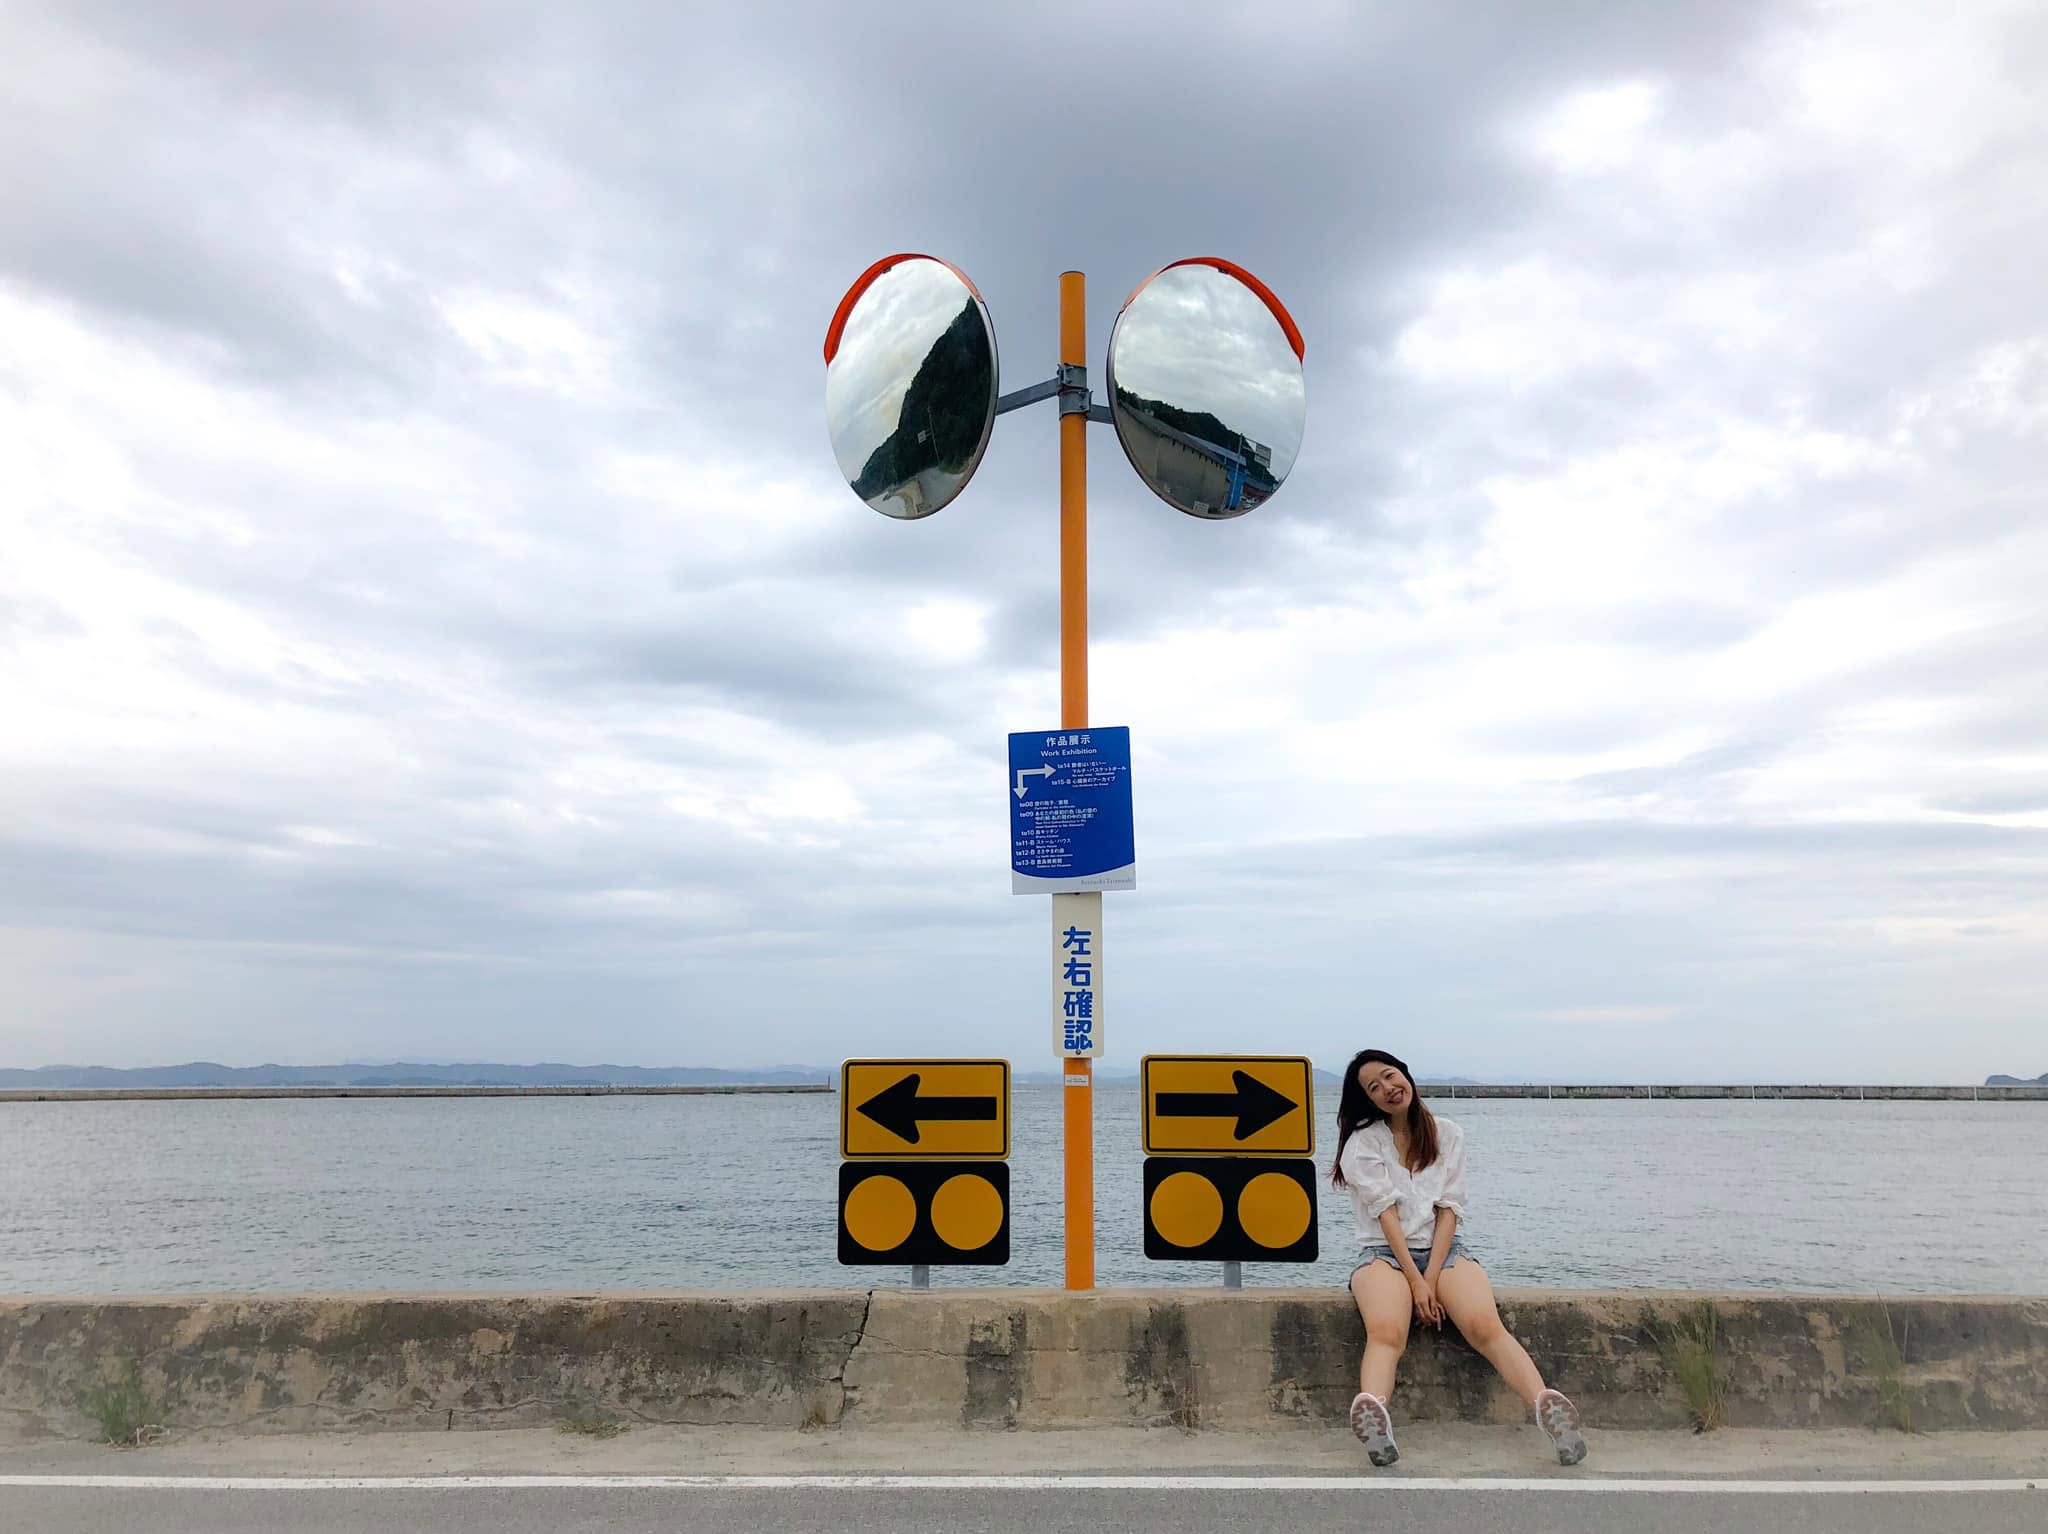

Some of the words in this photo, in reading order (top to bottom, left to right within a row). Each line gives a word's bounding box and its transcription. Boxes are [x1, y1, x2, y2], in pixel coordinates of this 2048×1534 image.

[1046, 734, 1091, 747] 作品展示
[1062, 748, 1097, 756] Exhibition
[1062, 925, 1093, 1050] 左右確認
